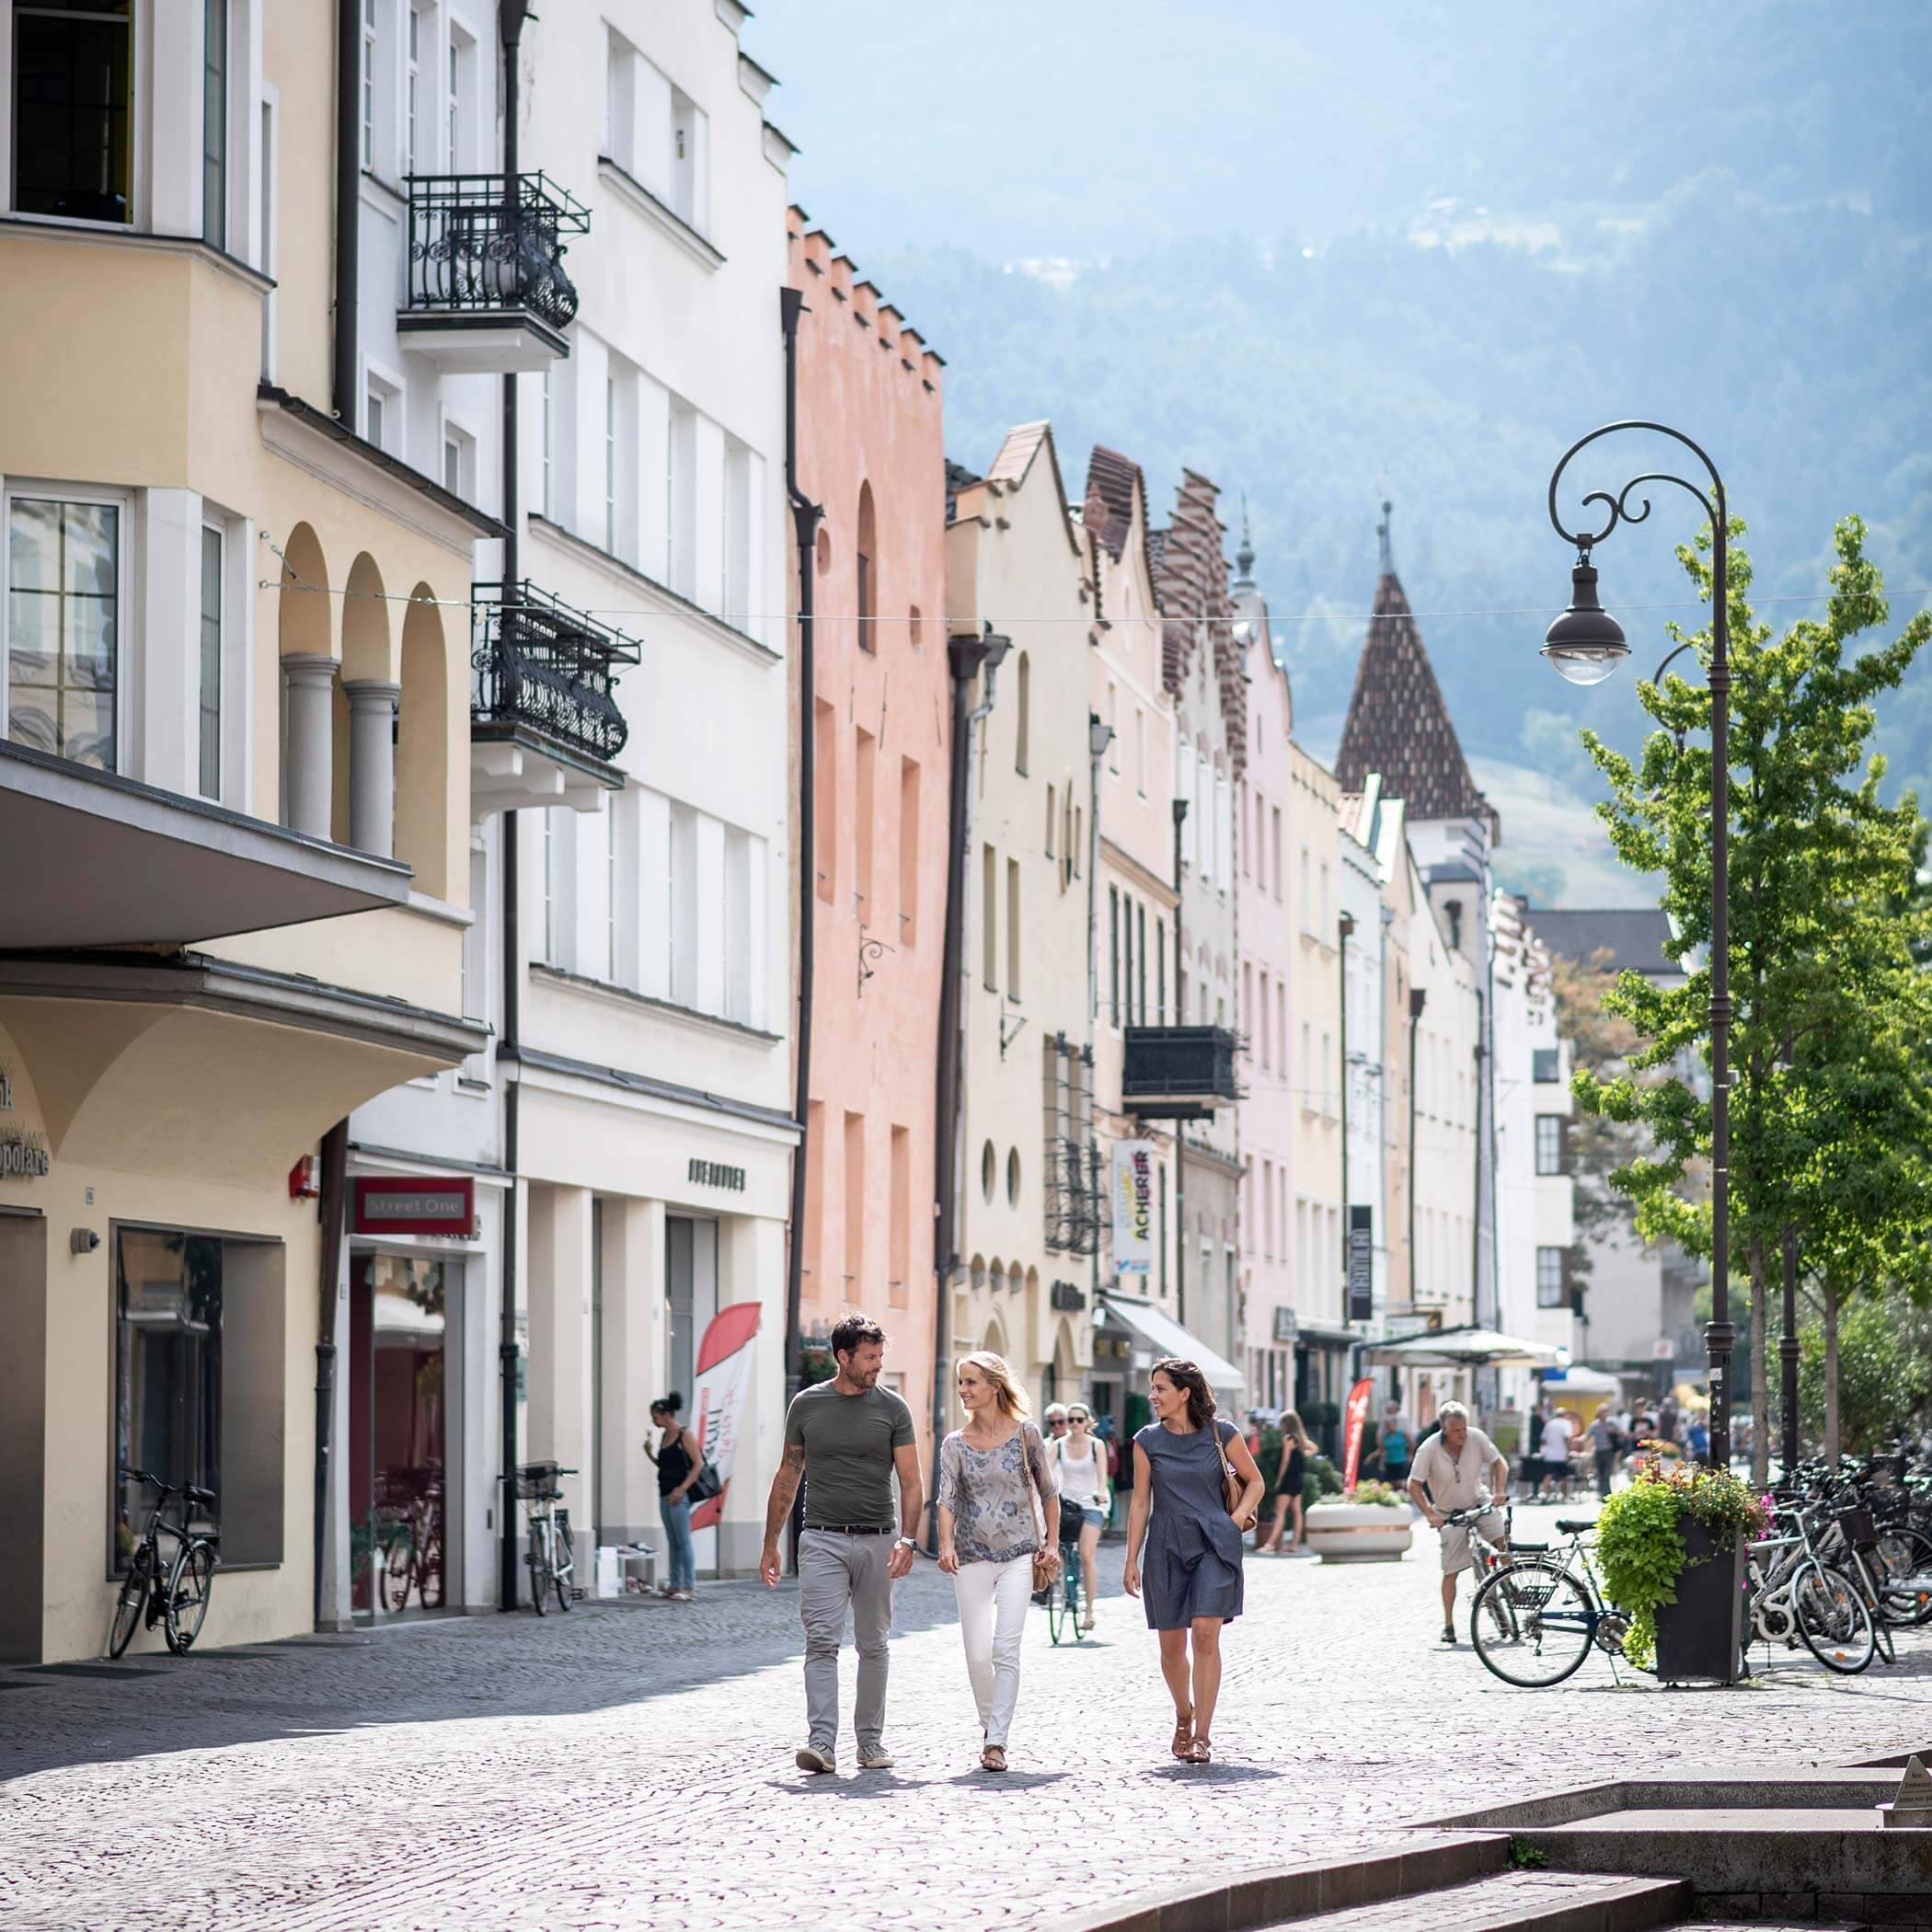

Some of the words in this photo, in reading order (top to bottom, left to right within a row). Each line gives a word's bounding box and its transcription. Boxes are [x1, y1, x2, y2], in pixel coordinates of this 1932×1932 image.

[0, 1139, 50, 1180] polare
[370, 1199, 420, 1213] Street
[425, 1199, 459, 1213] One
[1135, 1151, 1149, 1241] ACHERER
